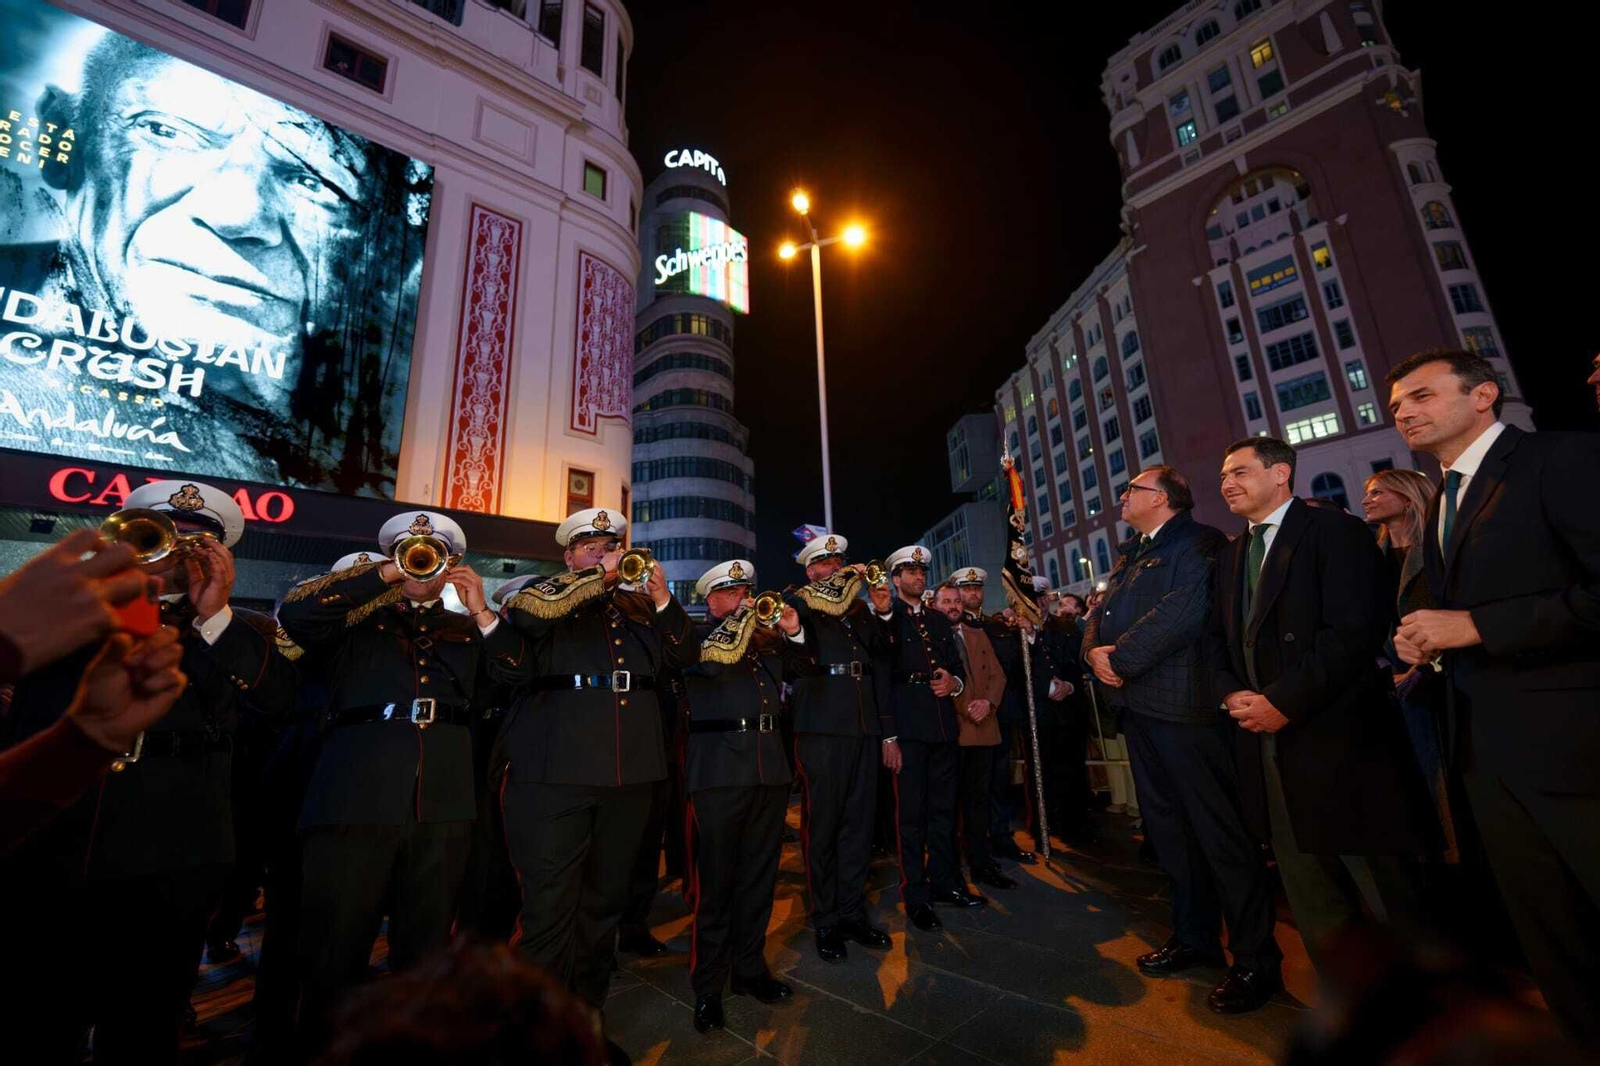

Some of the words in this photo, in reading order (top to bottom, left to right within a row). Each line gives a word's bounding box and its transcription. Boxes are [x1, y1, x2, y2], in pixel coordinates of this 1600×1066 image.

[655, 241, 748, 285] Schweppes
[0, 286, 286, 380] DALUSIAN
[0, 389, 192, 453] Andalucía
[48, 379, 165, 408] ICASSO
[48, 466, 295, 524] CAAO
